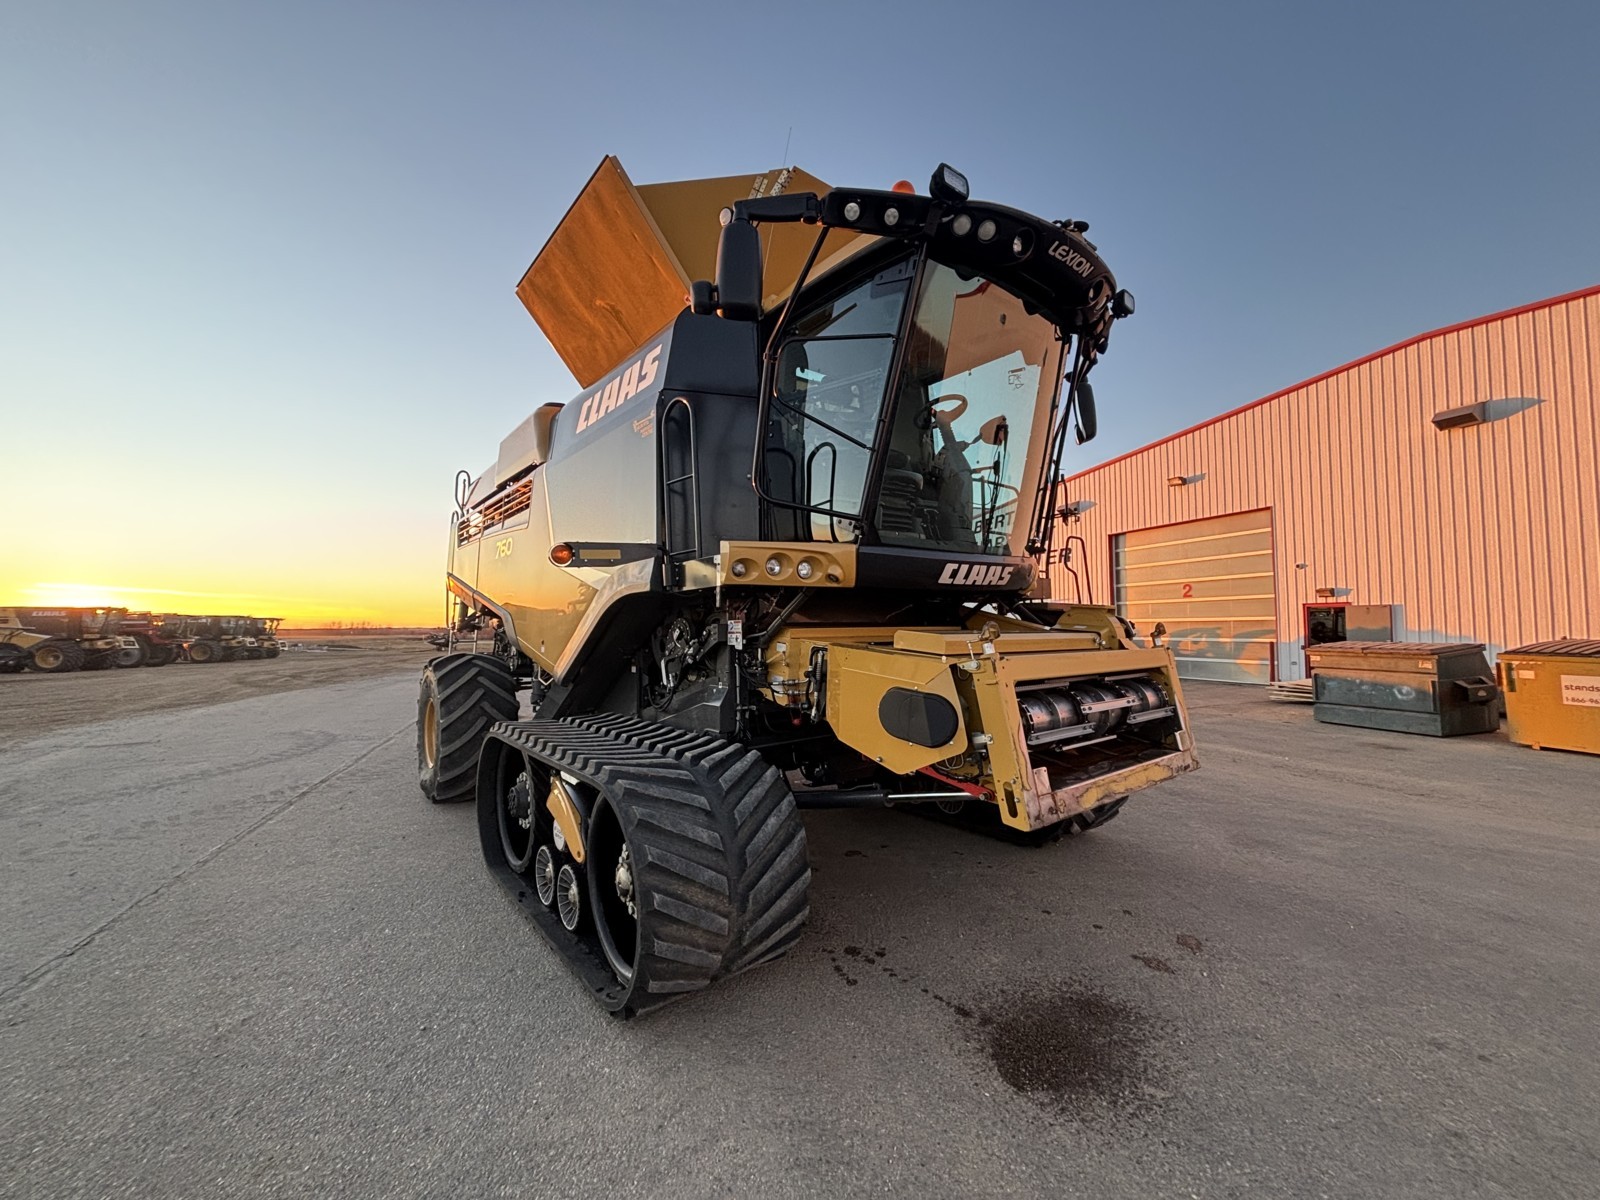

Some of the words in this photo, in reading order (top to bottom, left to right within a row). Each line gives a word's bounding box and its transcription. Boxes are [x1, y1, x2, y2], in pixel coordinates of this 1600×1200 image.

[1048, 241, 1094, 278] LEXION
[576, 344, 662, 434] CLAAS
[496, 537, 513, 559] 760
[938, 563, 1014, 586] CLAAS
[1183, 584, 1193, 599] 2
